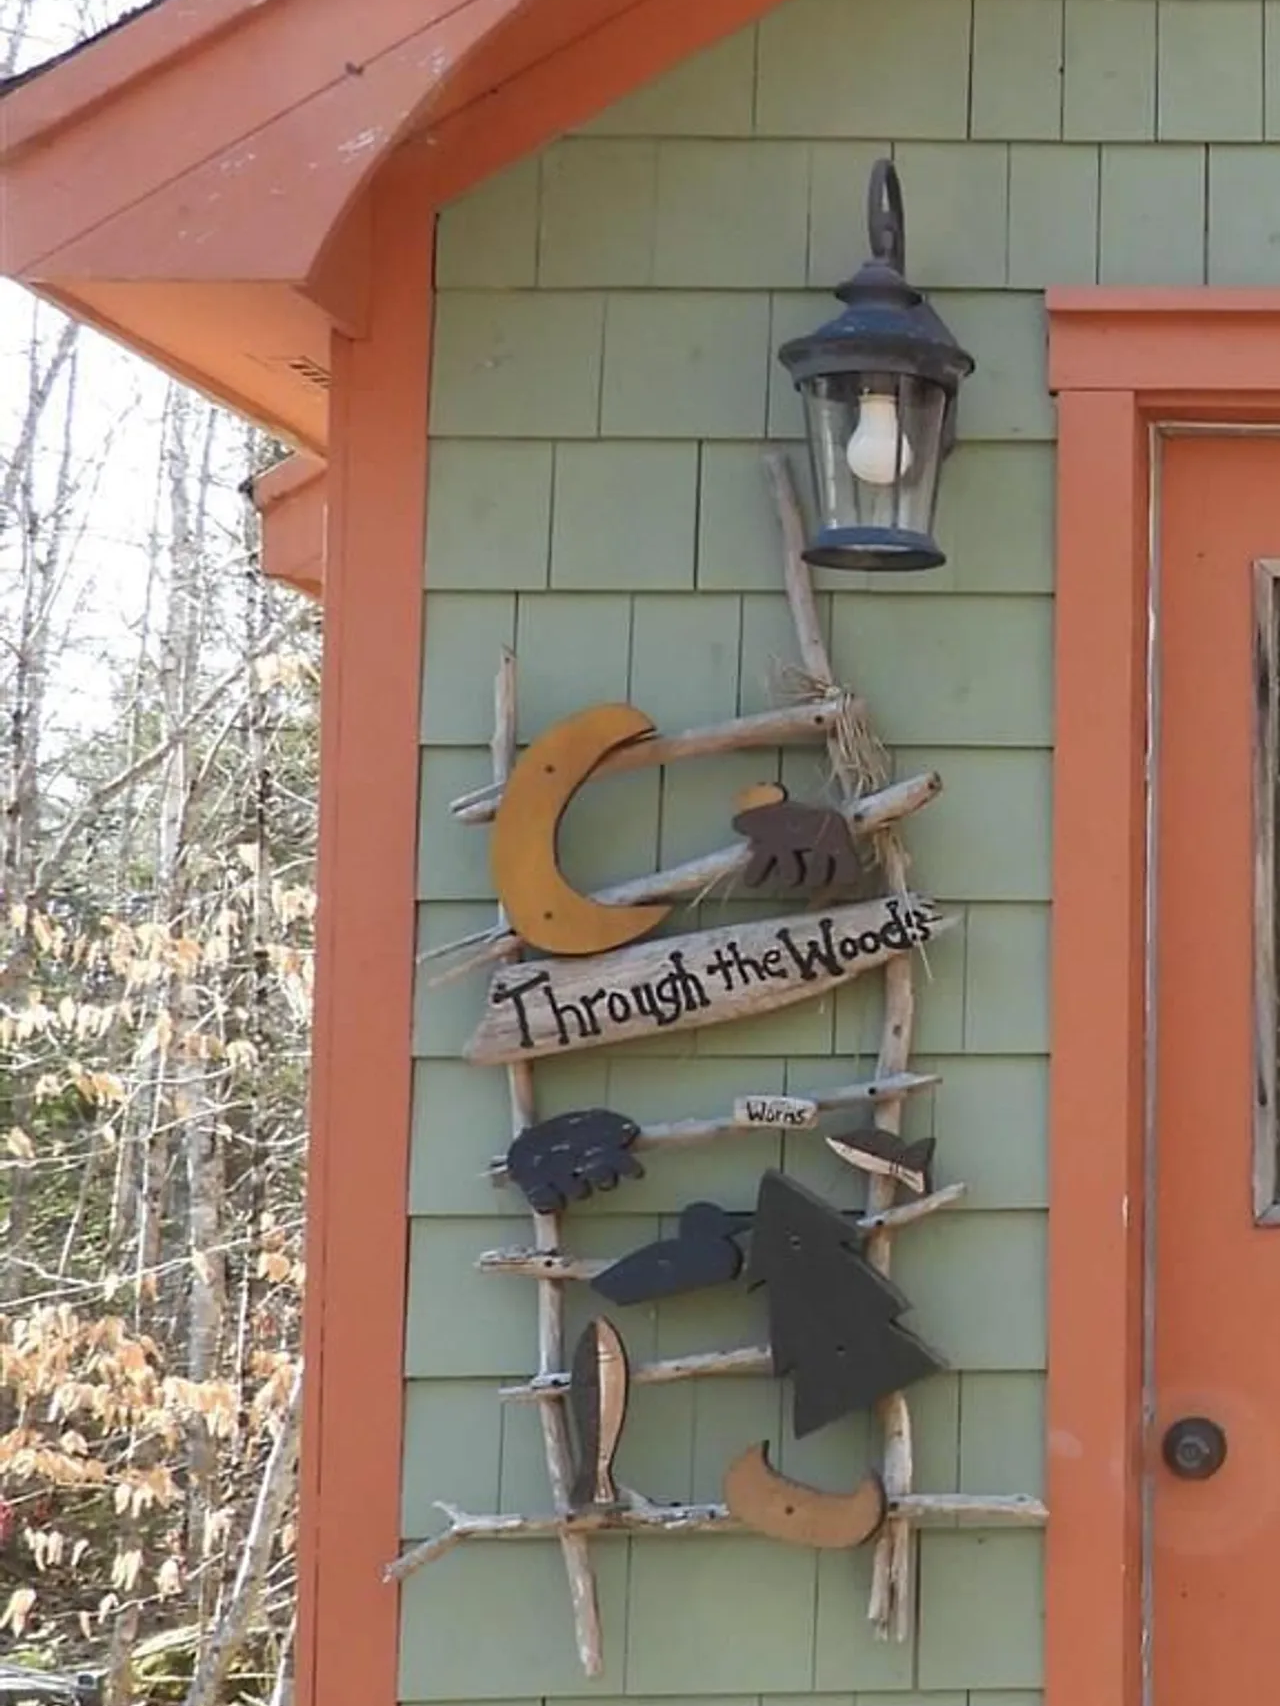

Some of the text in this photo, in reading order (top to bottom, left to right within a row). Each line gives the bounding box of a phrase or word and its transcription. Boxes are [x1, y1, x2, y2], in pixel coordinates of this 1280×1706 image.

[492, 899, 933, 1049] Through the Woods
[746, 1100, 807, 1125] Worms
